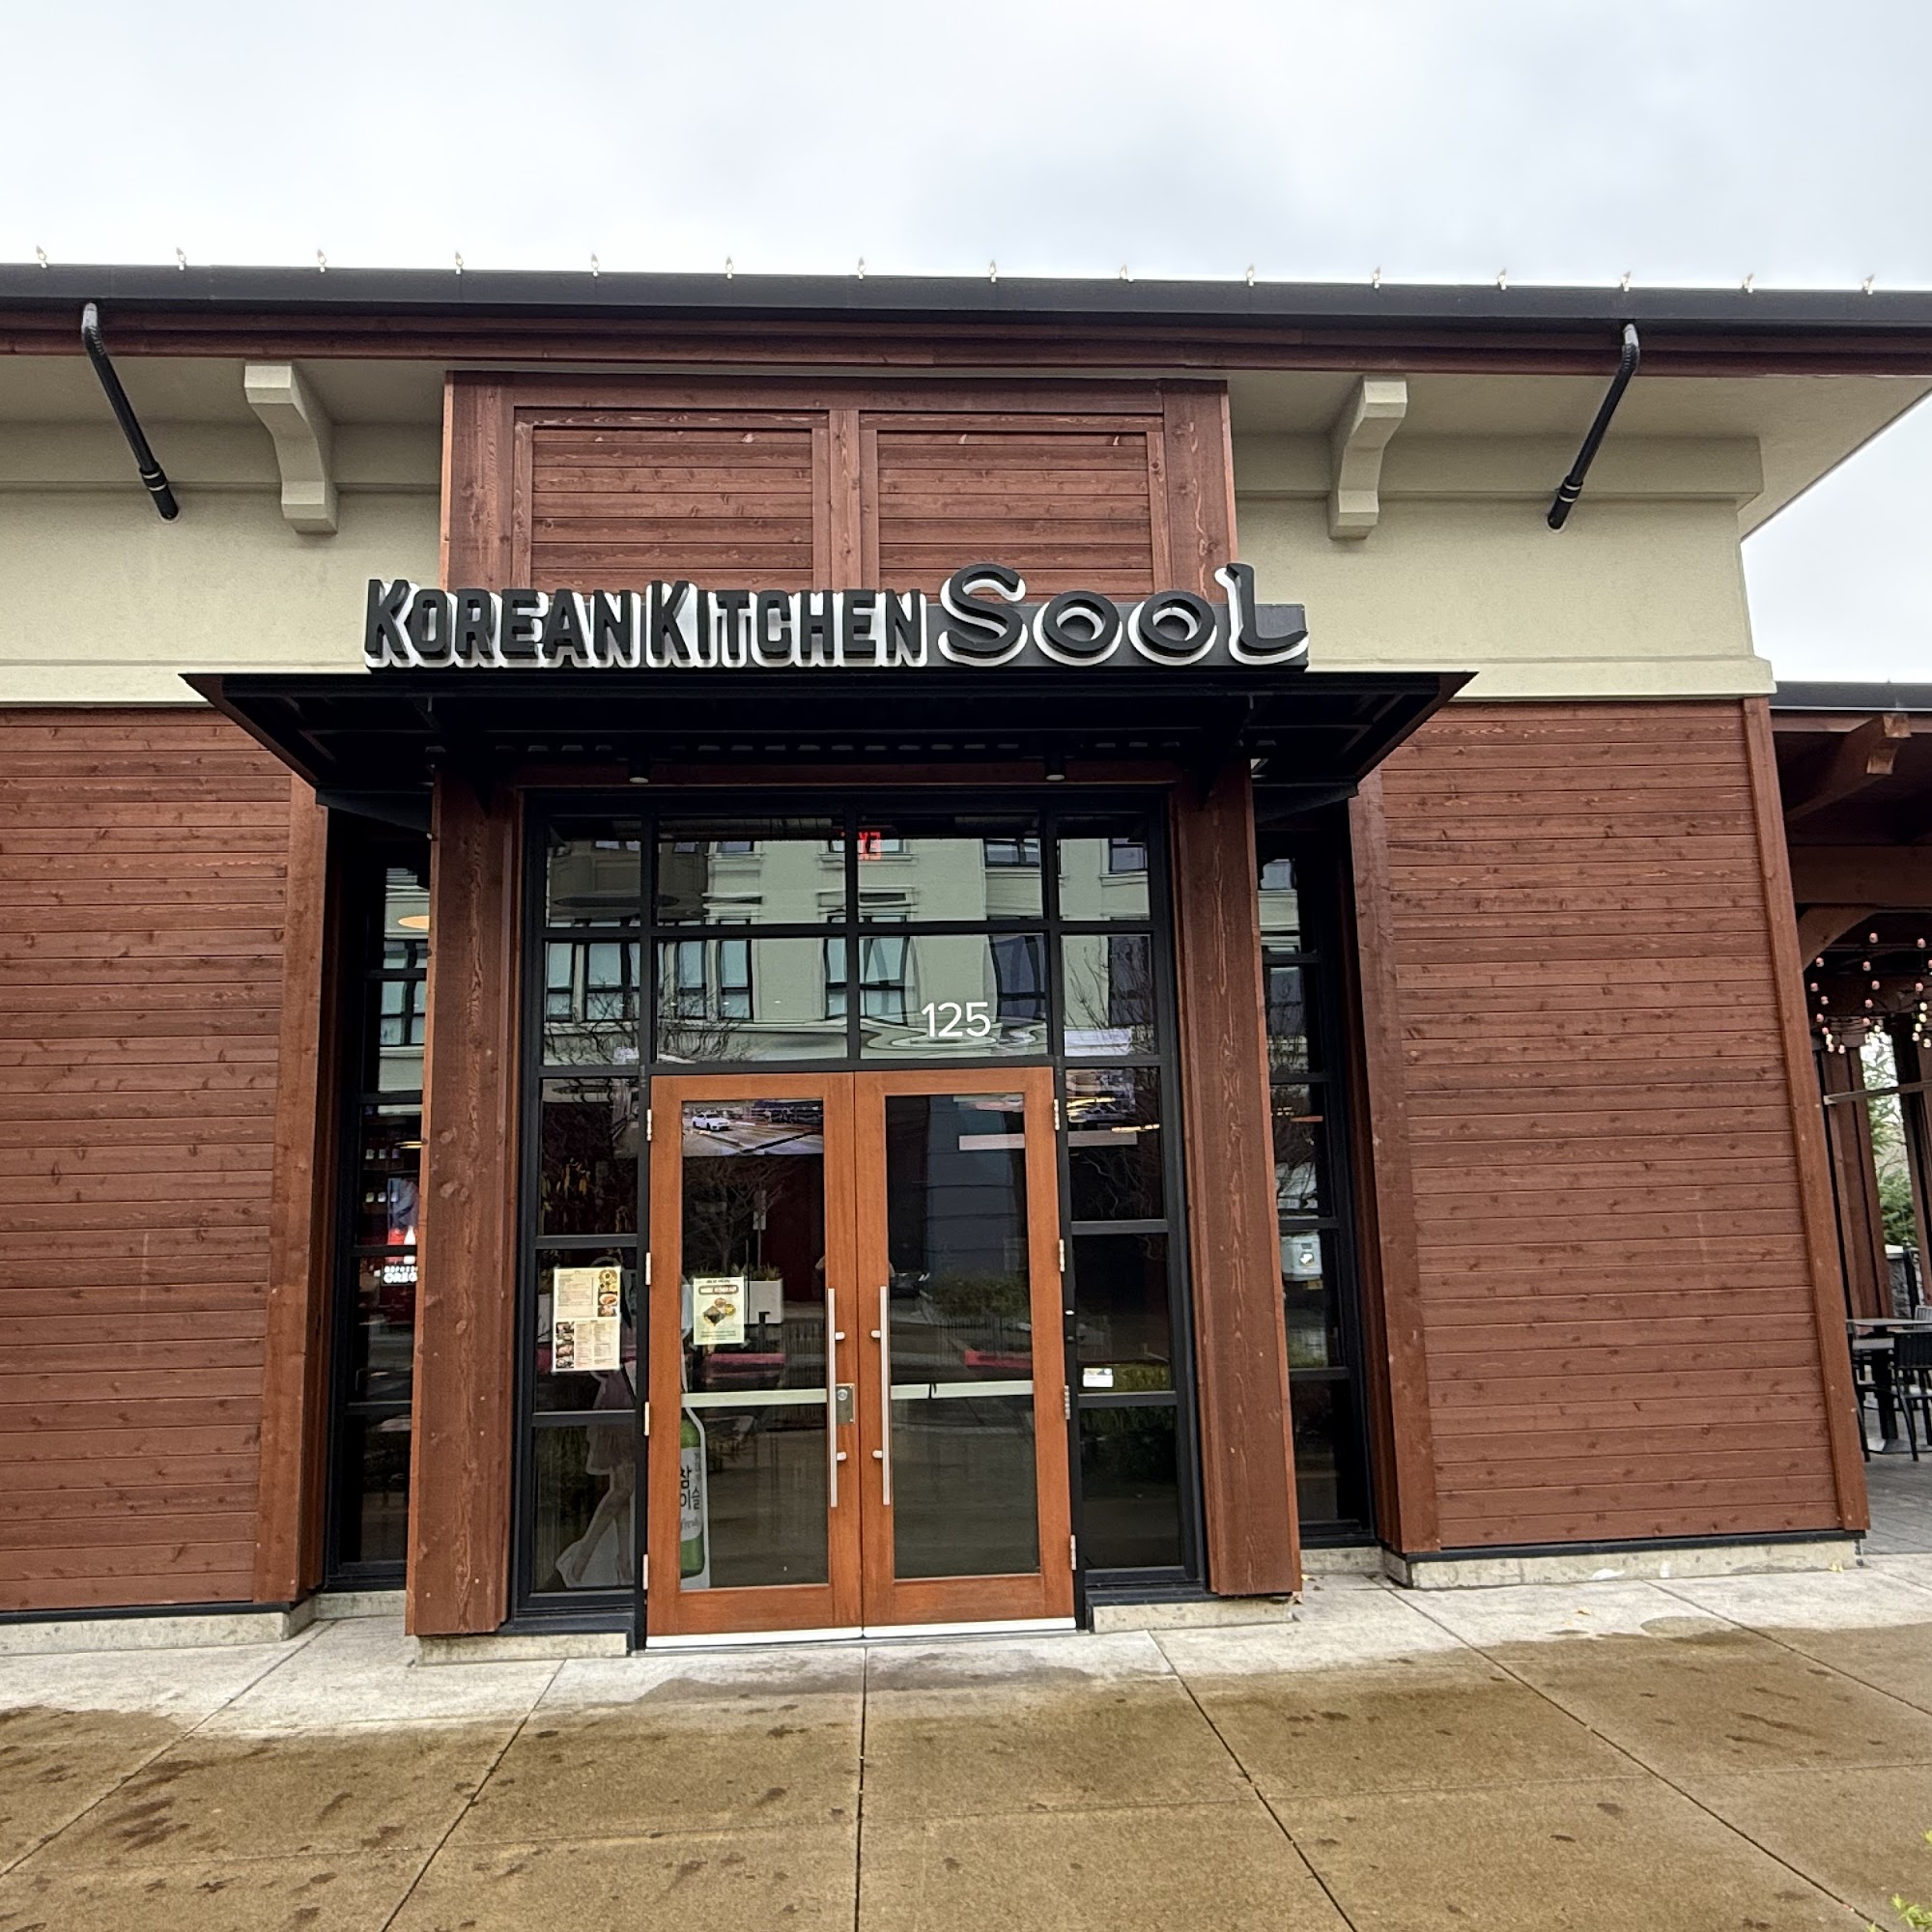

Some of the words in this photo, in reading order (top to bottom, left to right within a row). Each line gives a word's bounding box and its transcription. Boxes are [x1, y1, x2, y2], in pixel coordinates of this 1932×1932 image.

[364, 579, 638, 666] KOREAN
[646, 580, 926, 667] KITCHEN
[939, 563, 1309, 666] SOOL
[921, 1001, 991, 1037] 125
